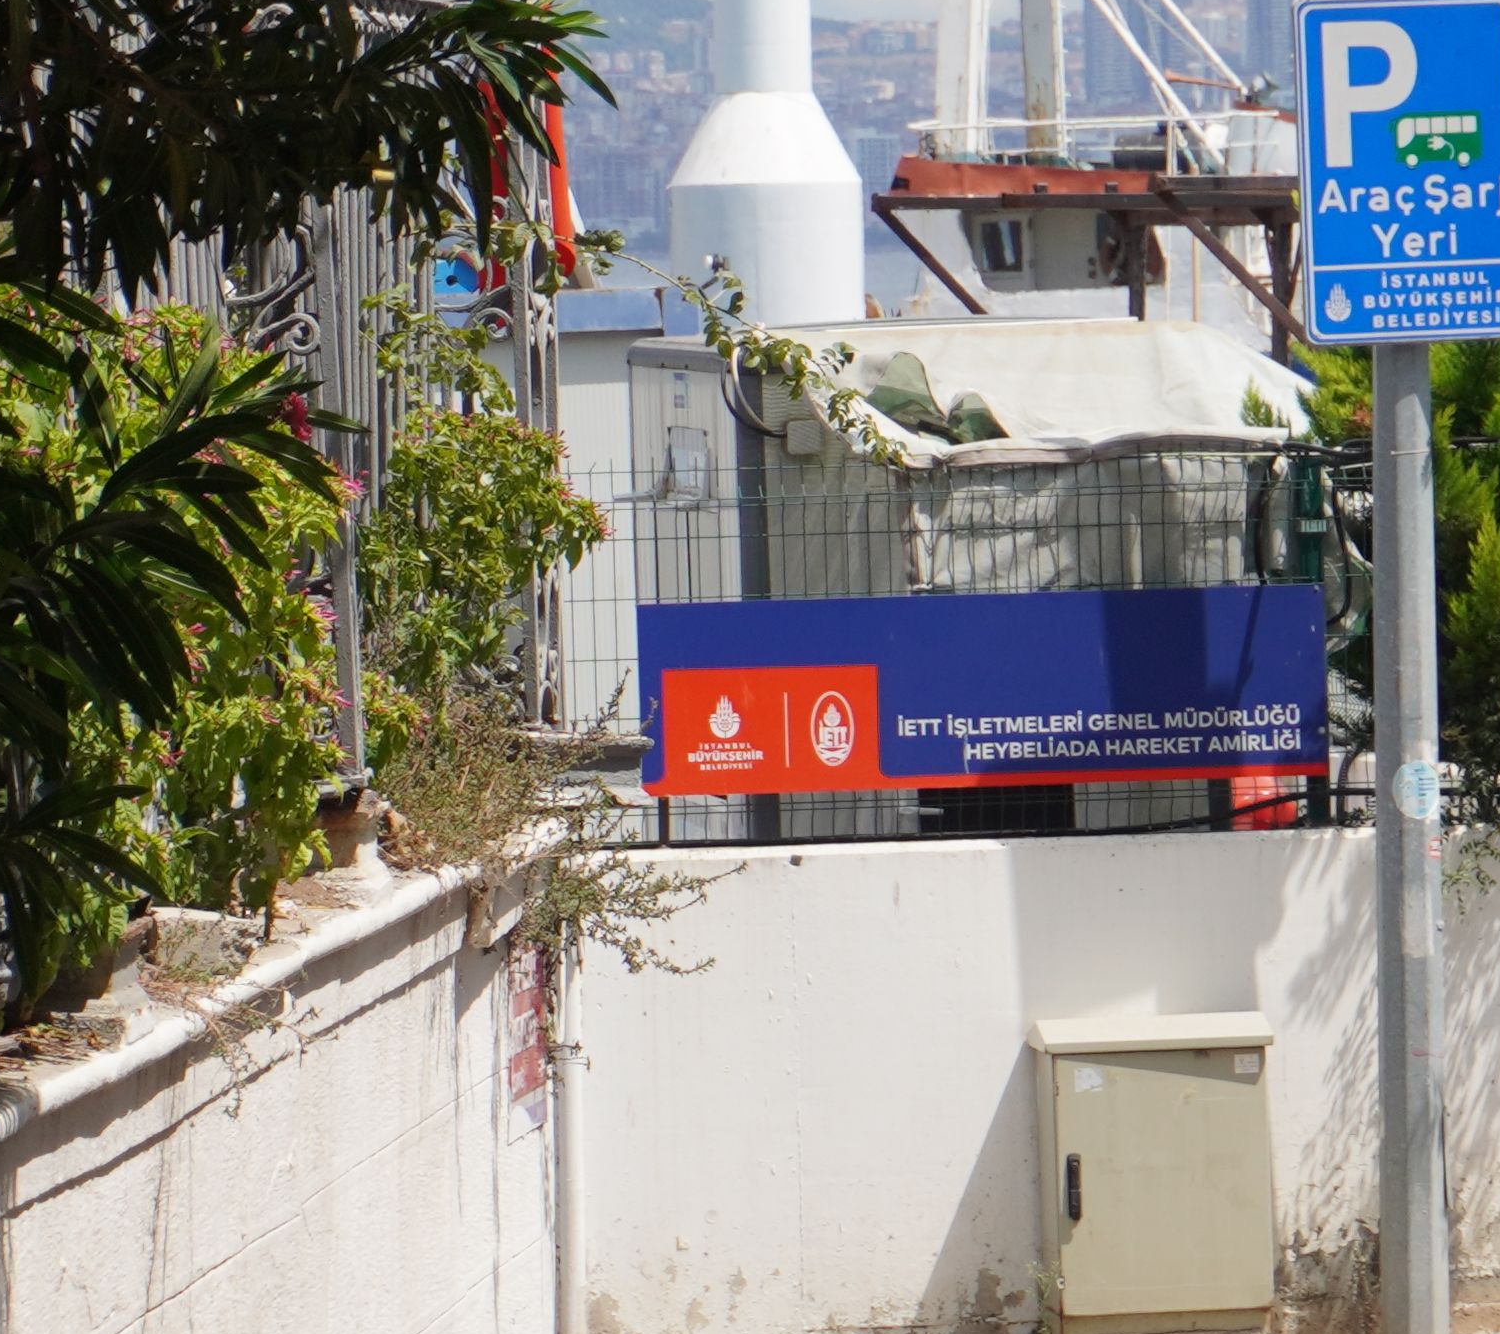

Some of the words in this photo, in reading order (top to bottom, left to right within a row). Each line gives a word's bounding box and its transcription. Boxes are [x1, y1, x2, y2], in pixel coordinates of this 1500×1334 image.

[1321, 21, 1418, 168] P
[1318, 178, 1415, 216] Araç
[1371, 223, 1458, 258] Yeri
[1381, 270, 1489, 289] İSTANBUL
[897, 714, 942, 737] İETT
[946, 710, 1083, 738] İŞLETMELERİ
[1088, 713, 1160, 731] GENEL
[1165, 703, 1301, 729] MÜDÜRLÜĞÜ
[967, 736, 1101, 760] HEYBELİADA
[1105, 736, 1203, 756] HAREKET
[1207, 728, 1301, 753] AMİRLİĞİ
